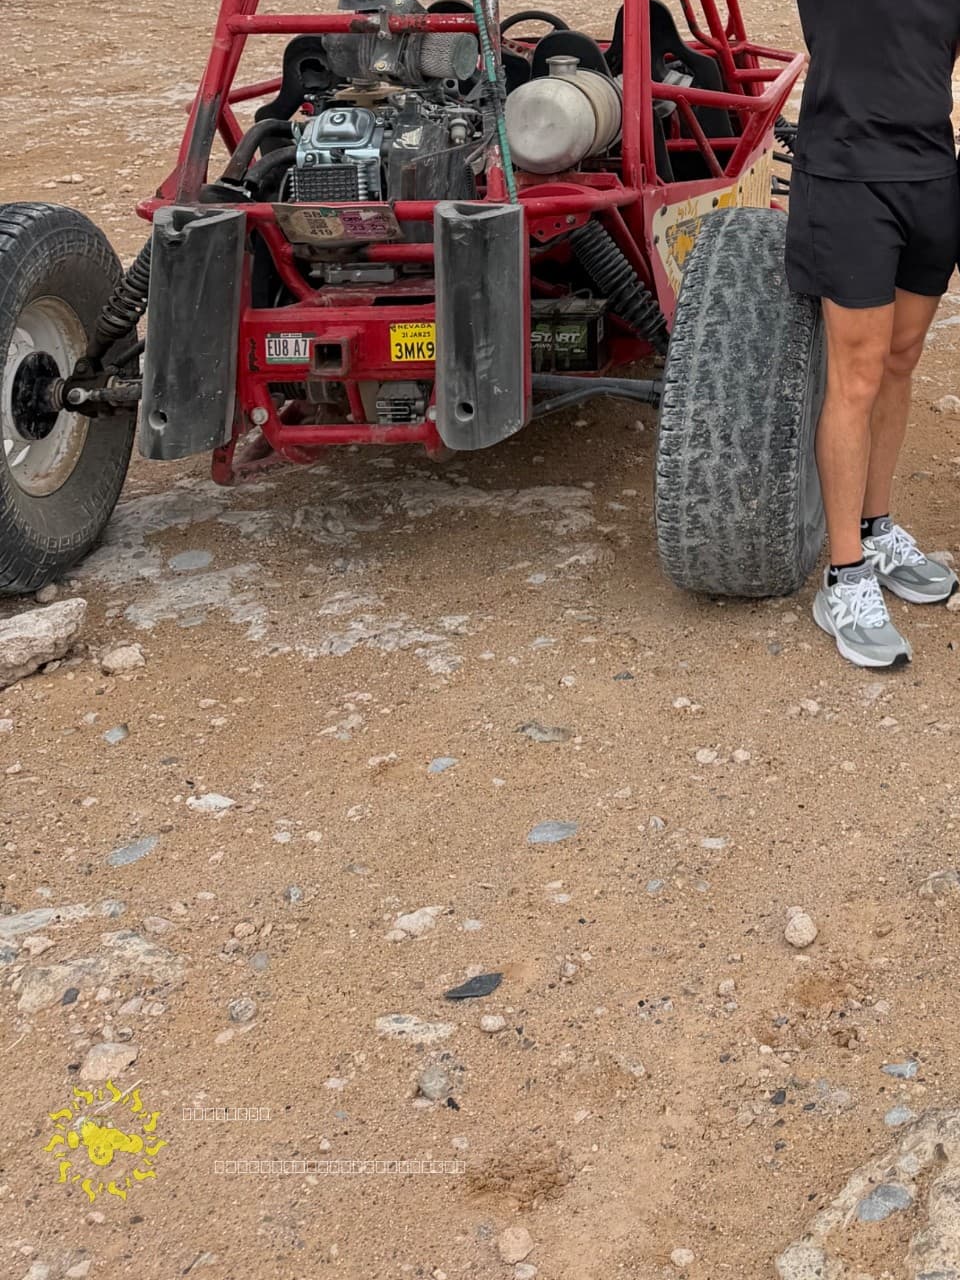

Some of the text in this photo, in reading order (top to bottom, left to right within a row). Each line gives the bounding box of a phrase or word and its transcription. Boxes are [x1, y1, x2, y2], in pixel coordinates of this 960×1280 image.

[267, 339, 289, 357] EU8
[293, 339, 308, 357] A7
[395, 342, 435, 360] 3MK9
